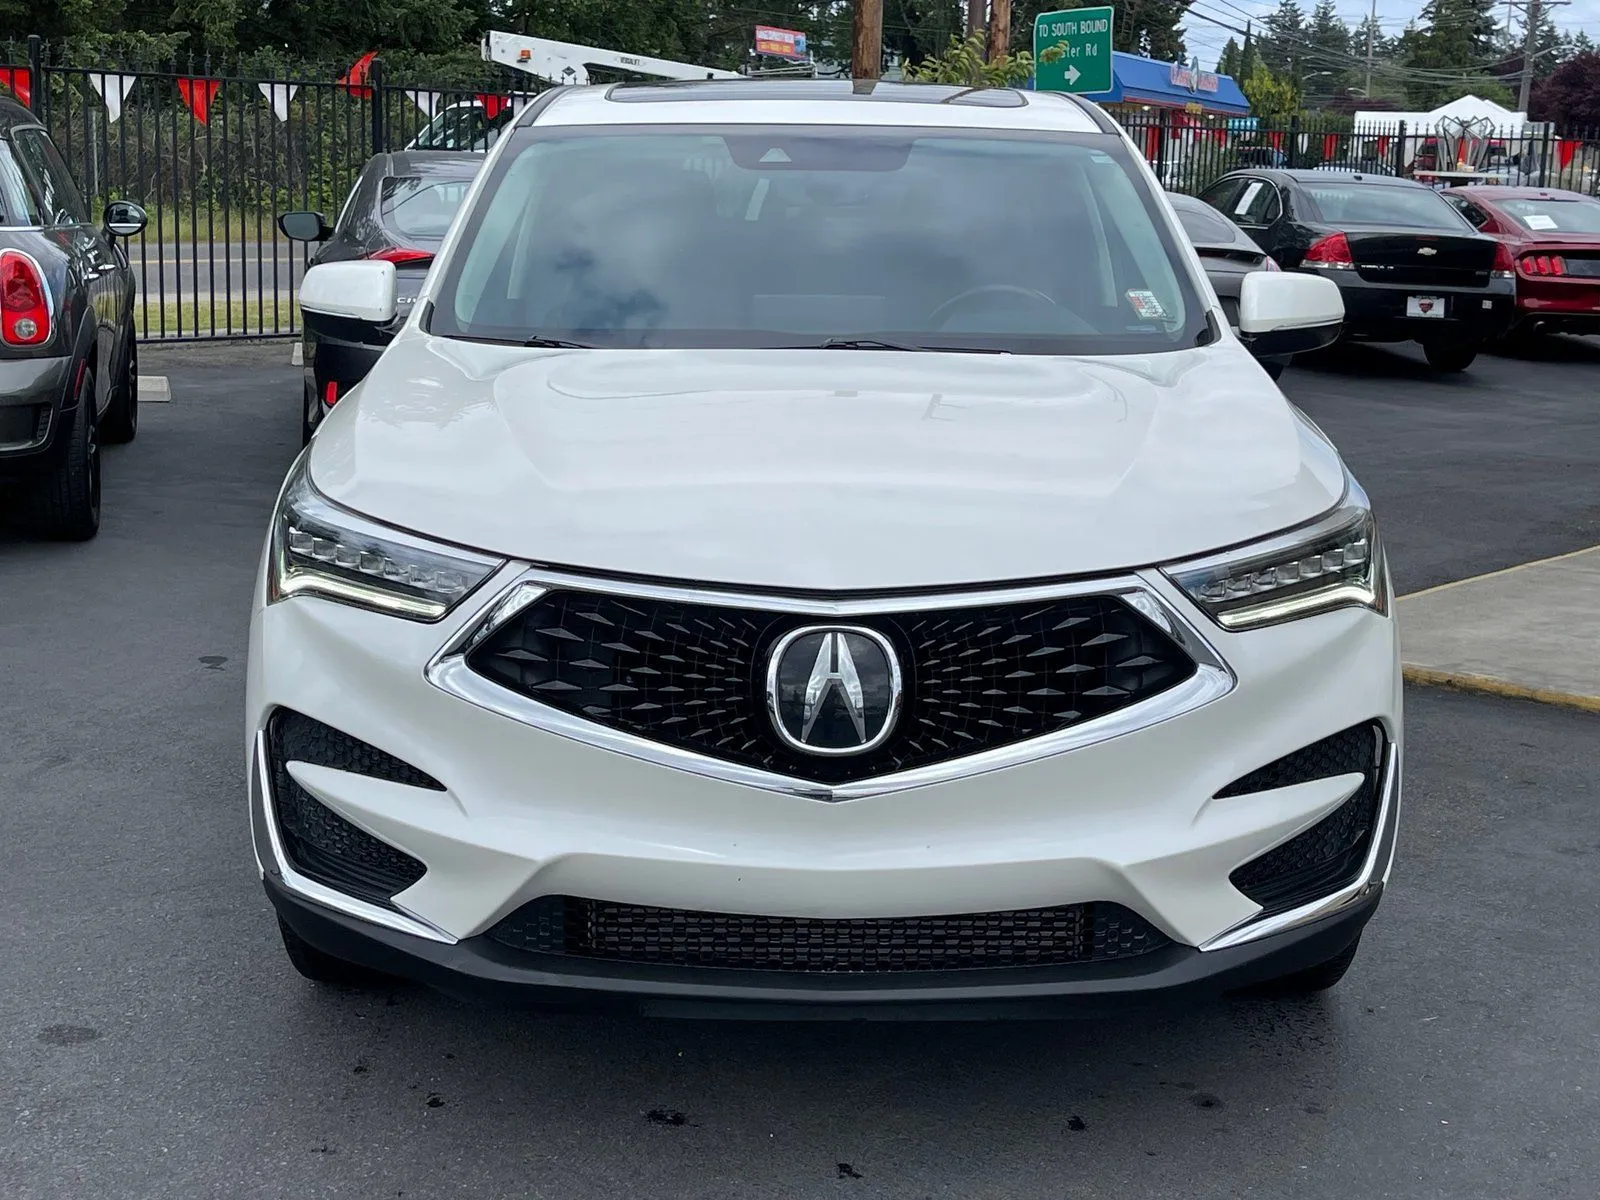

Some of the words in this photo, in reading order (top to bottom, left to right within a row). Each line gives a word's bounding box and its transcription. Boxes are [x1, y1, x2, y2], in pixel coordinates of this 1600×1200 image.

[1038, 24, 1048, 37] TO
[1051, 22, 1077, 36] SOUTH
[1080, 19, 1108, 34] BOUND
[1085, 43, 1097, 56] Rd
